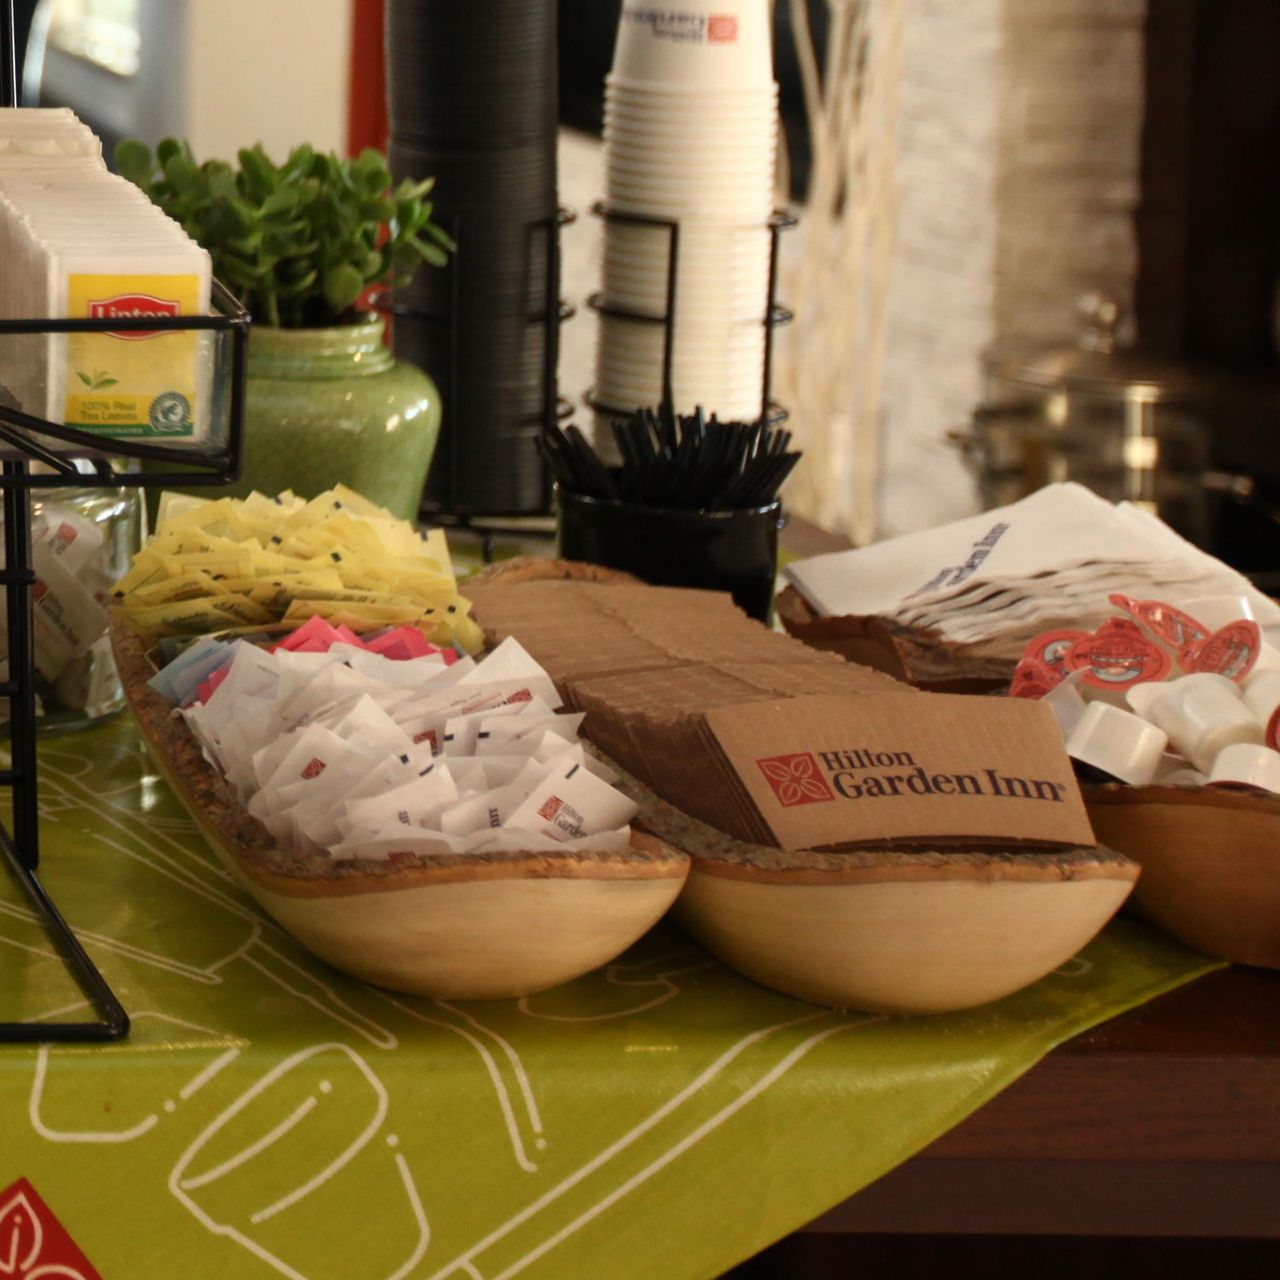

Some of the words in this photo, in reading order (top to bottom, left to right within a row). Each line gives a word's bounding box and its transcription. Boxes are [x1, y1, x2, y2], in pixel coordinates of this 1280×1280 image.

[818, 748, 917, 772] Hilton
[833, 766, 987, 800] Garden
[981, 768, 1065, 803] Inn
